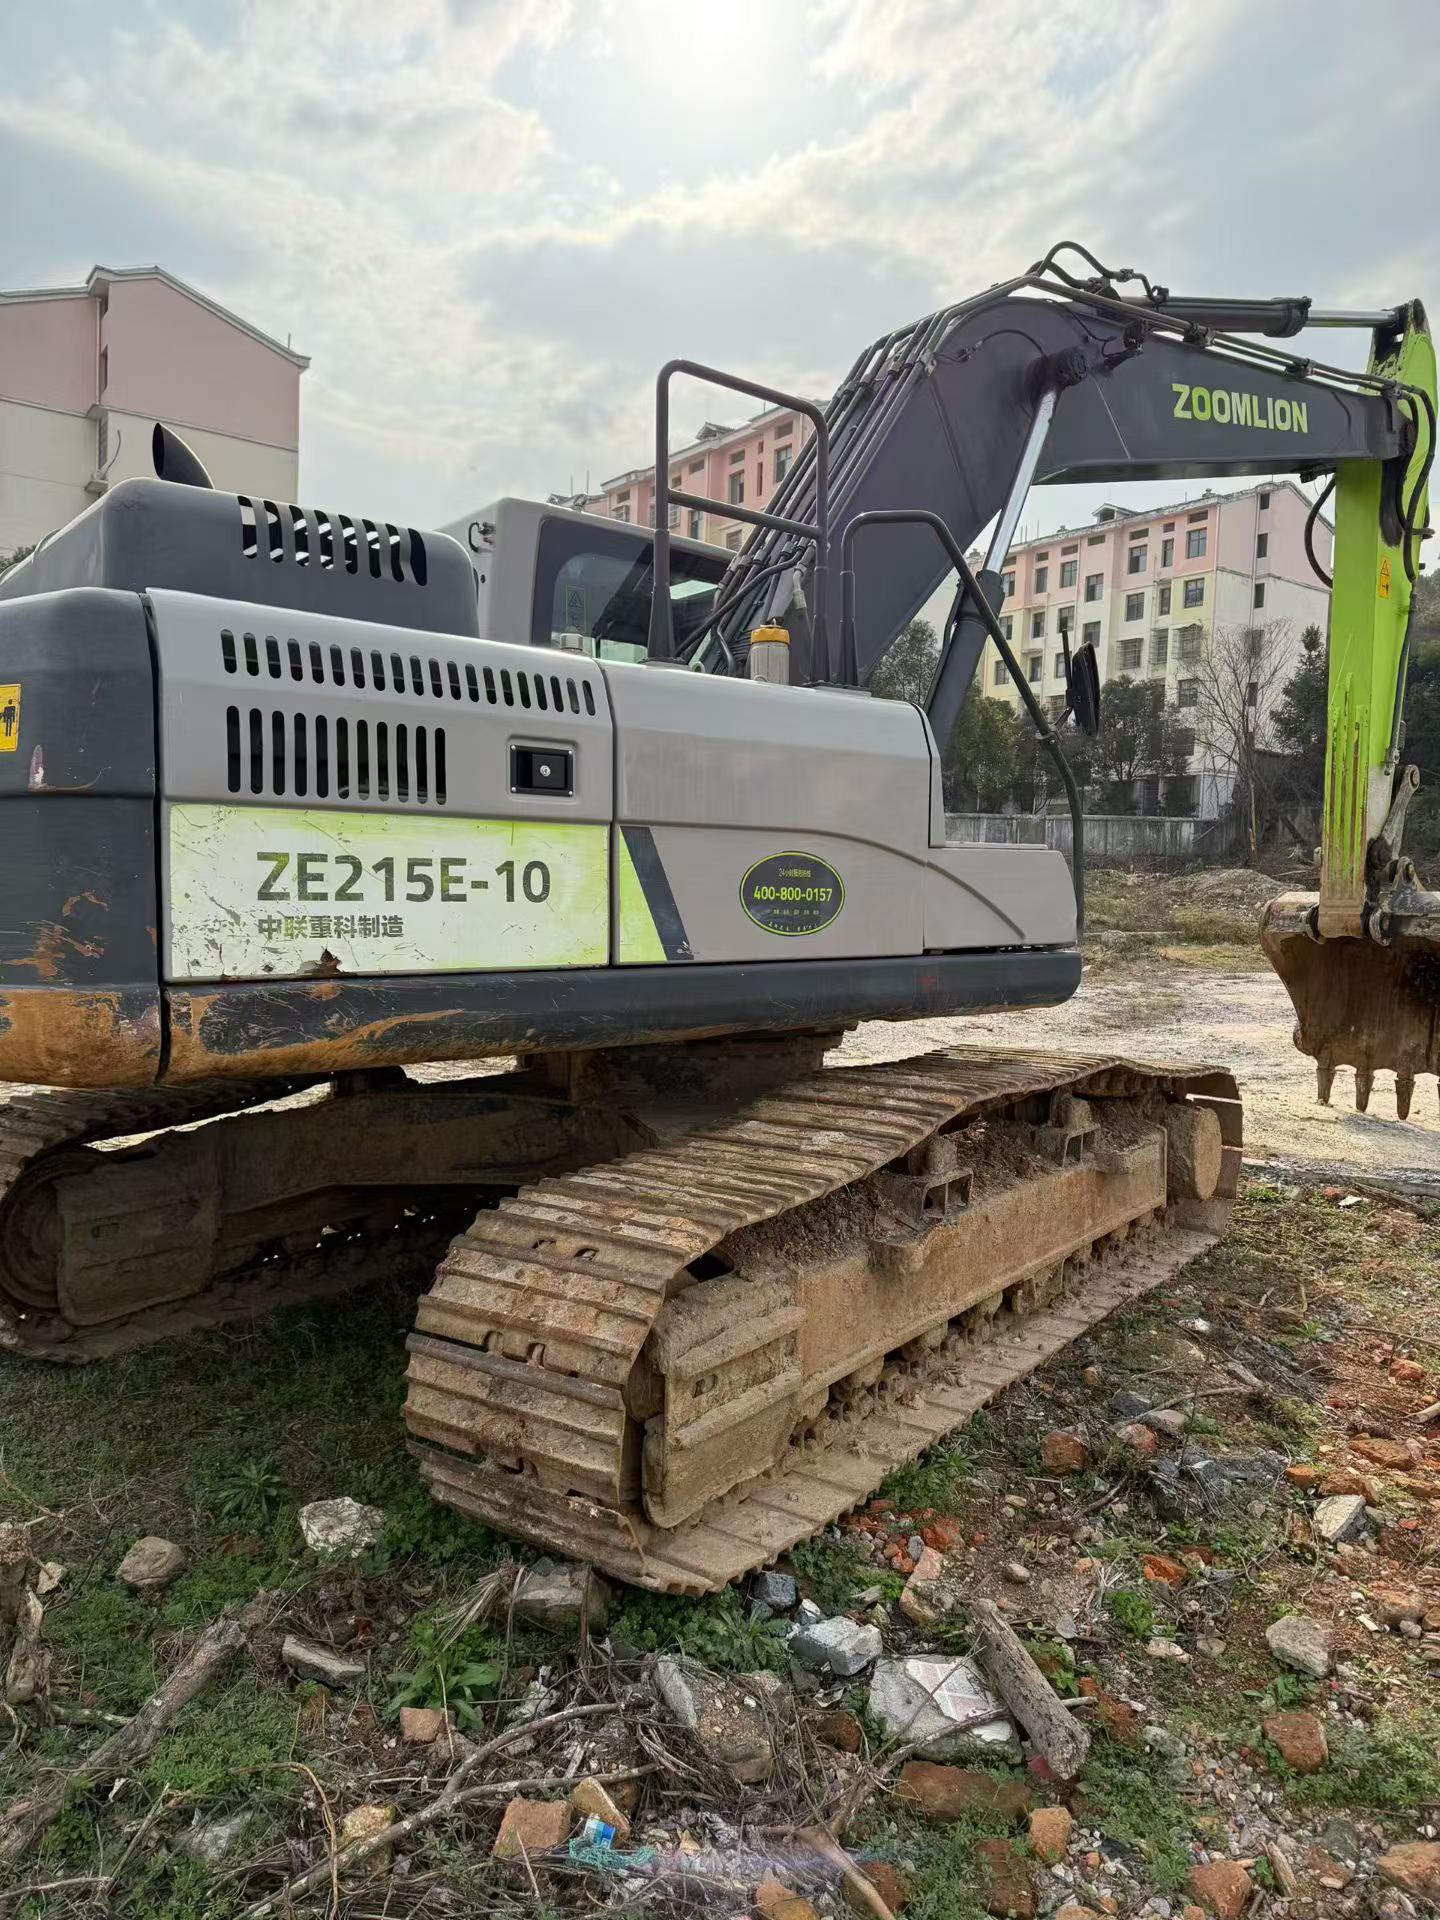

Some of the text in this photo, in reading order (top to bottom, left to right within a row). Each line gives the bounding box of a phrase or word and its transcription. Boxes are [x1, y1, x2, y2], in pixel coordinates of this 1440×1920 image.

[1171, 383, 1308, 433] ZOOMLION
[256, 851, 551, 903] ZE215E-10
[753, 885, 833, 902] 400-800-0157
[257, 914, 404, 940] 中联重科制造
